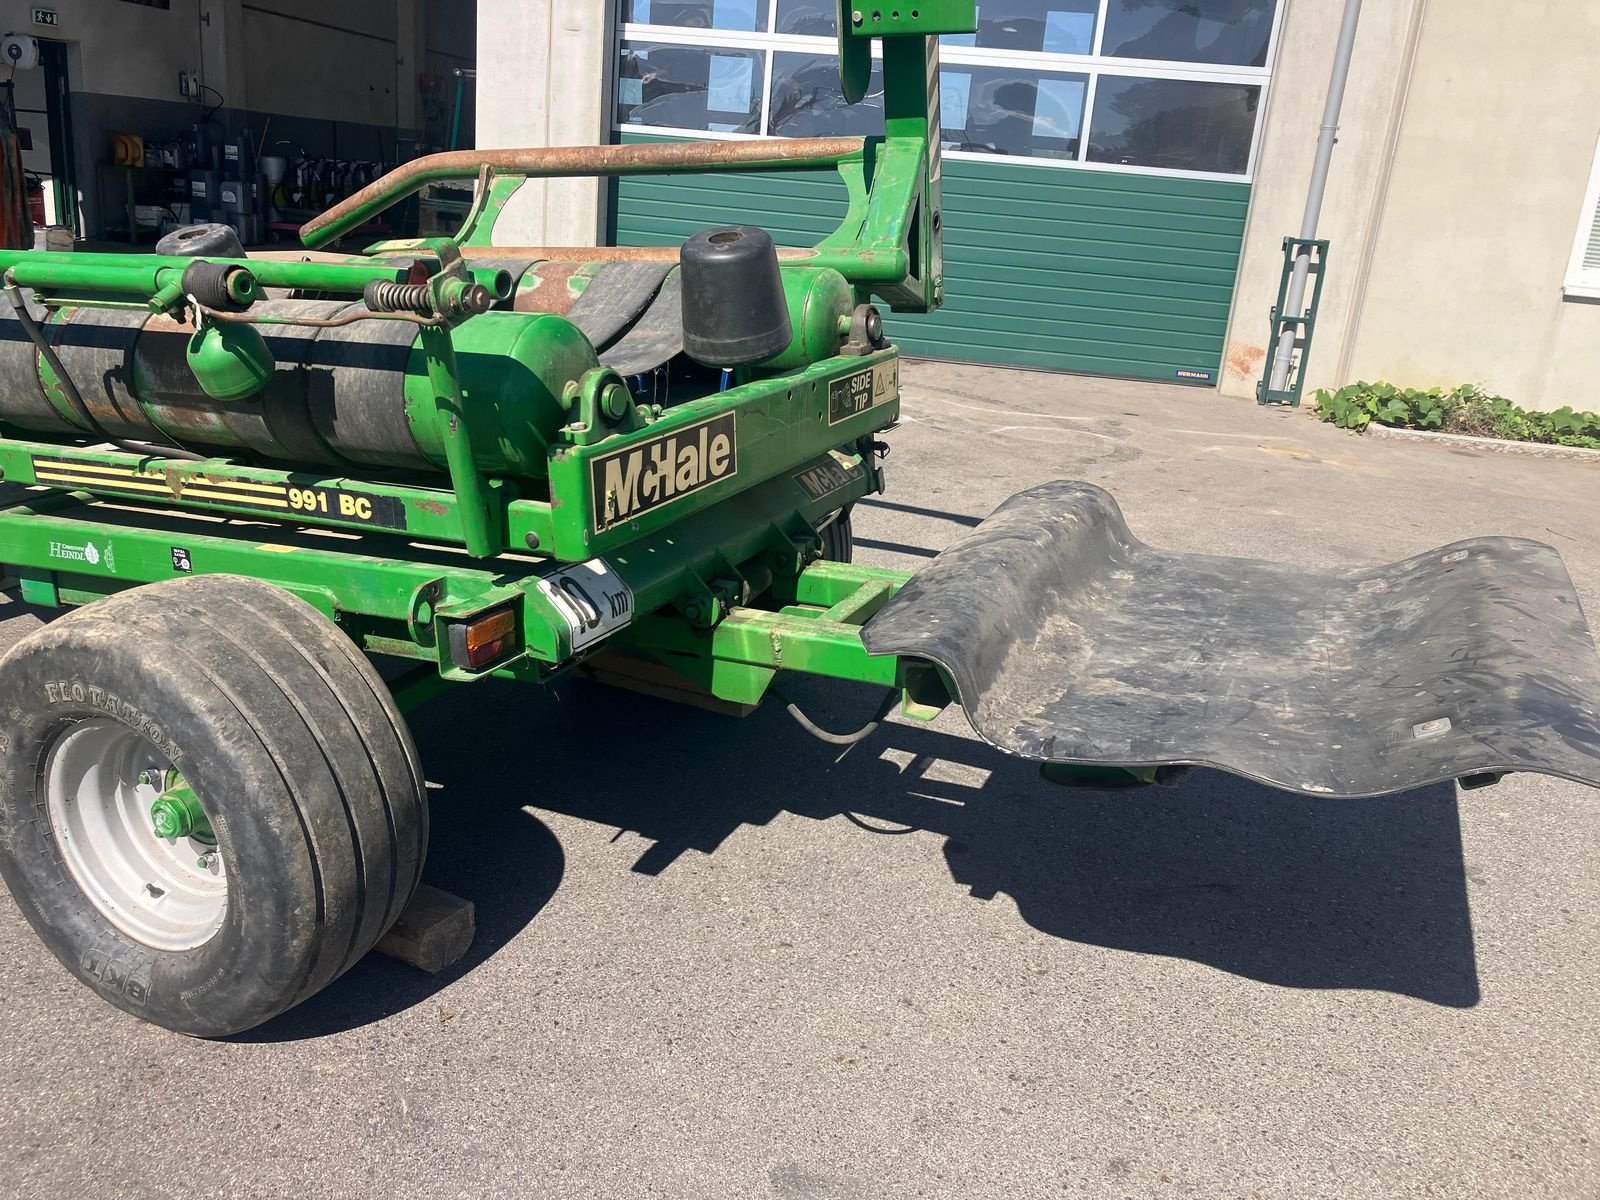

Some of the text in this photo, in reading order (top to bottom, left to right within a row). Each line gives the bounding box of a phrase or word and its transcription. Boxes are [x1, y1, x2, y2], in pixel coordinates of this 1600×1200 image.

[851, 372, 871, 394] SIDE
[854, 392, 868, 412] TIP
[603, 426, 731, 522] McHale
[289, 487, 373, 521] 991 BC
[49, 541, 86, 561] HEINDL
[602, 590, 629, 619] km
[45, 681, 185, 763] FLOTATION
[82, 953, 150, 1004] BKT
